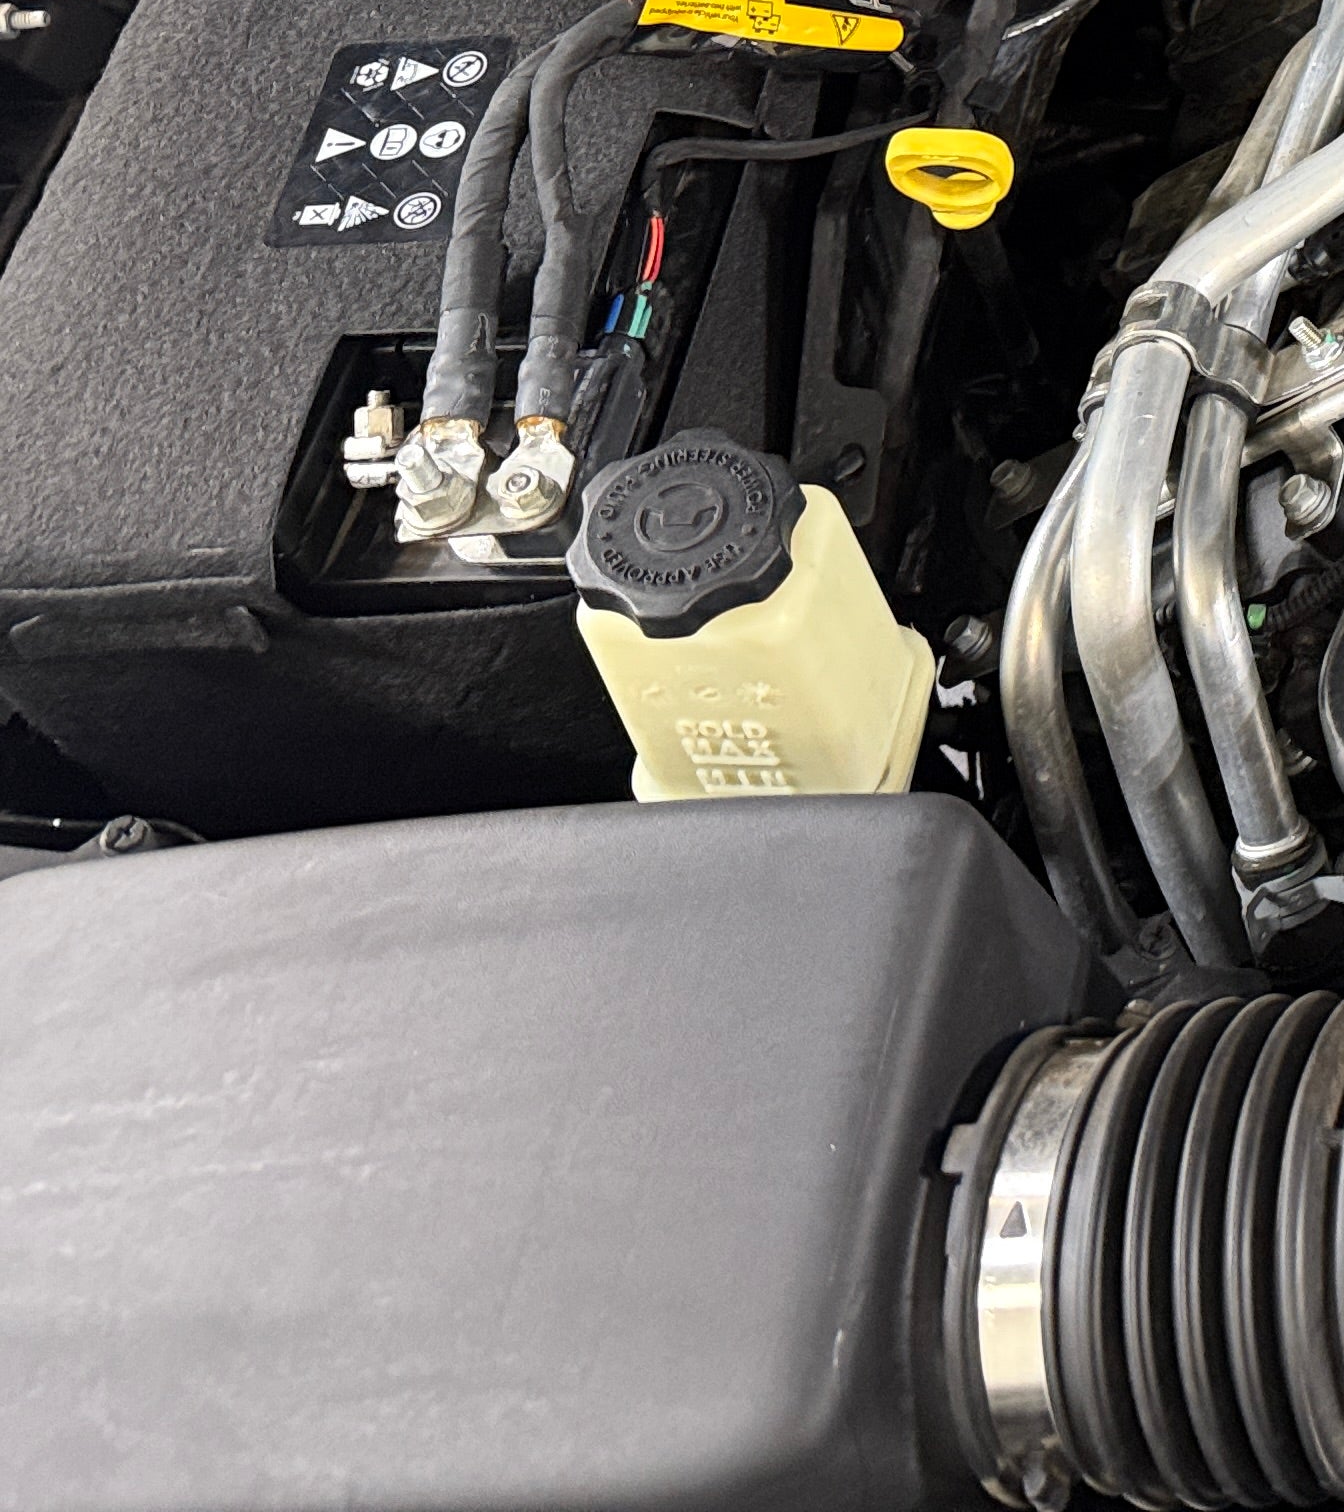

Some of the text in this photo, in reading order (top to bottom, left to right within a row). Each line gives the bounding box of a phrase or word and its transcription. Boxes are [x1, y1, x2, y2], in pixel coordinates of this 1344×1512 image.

[638, 449, 730, 475] STEERING
[730, 464, 762, 514] POWER
[602, 549, 696, 584] APPROVED
[676, 719, 768, 739] COLD
[682, 739, 772, 757] MAX
